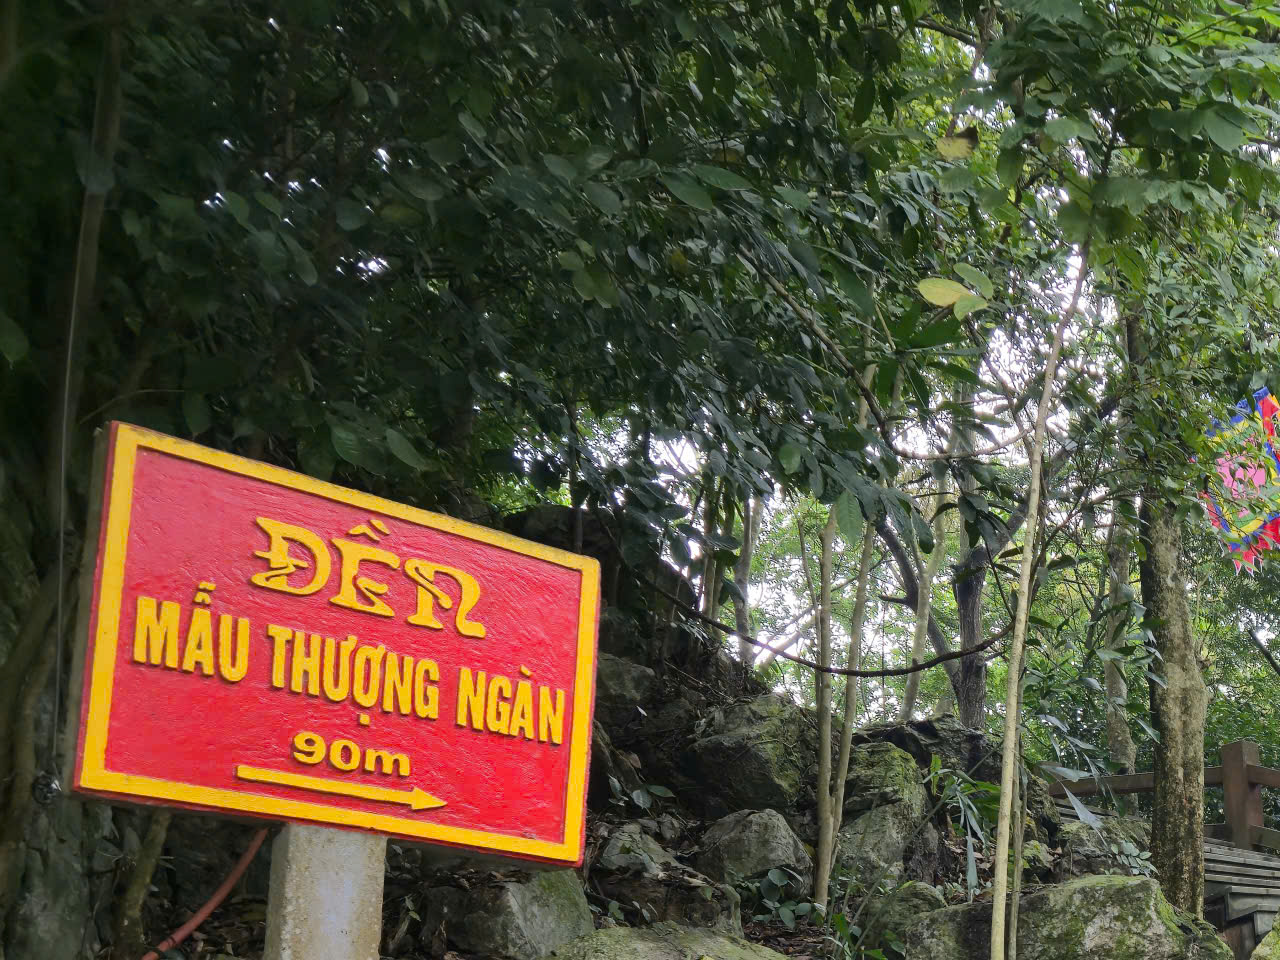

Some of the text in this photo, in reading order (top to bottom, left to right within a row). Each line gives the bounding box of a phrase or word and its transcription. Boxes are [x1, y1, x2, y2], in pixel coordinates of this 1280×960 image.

[133, 581, 566, 745] MẪU THƯỢNG NGÀN
[292, 731, 411, 777] 90m
